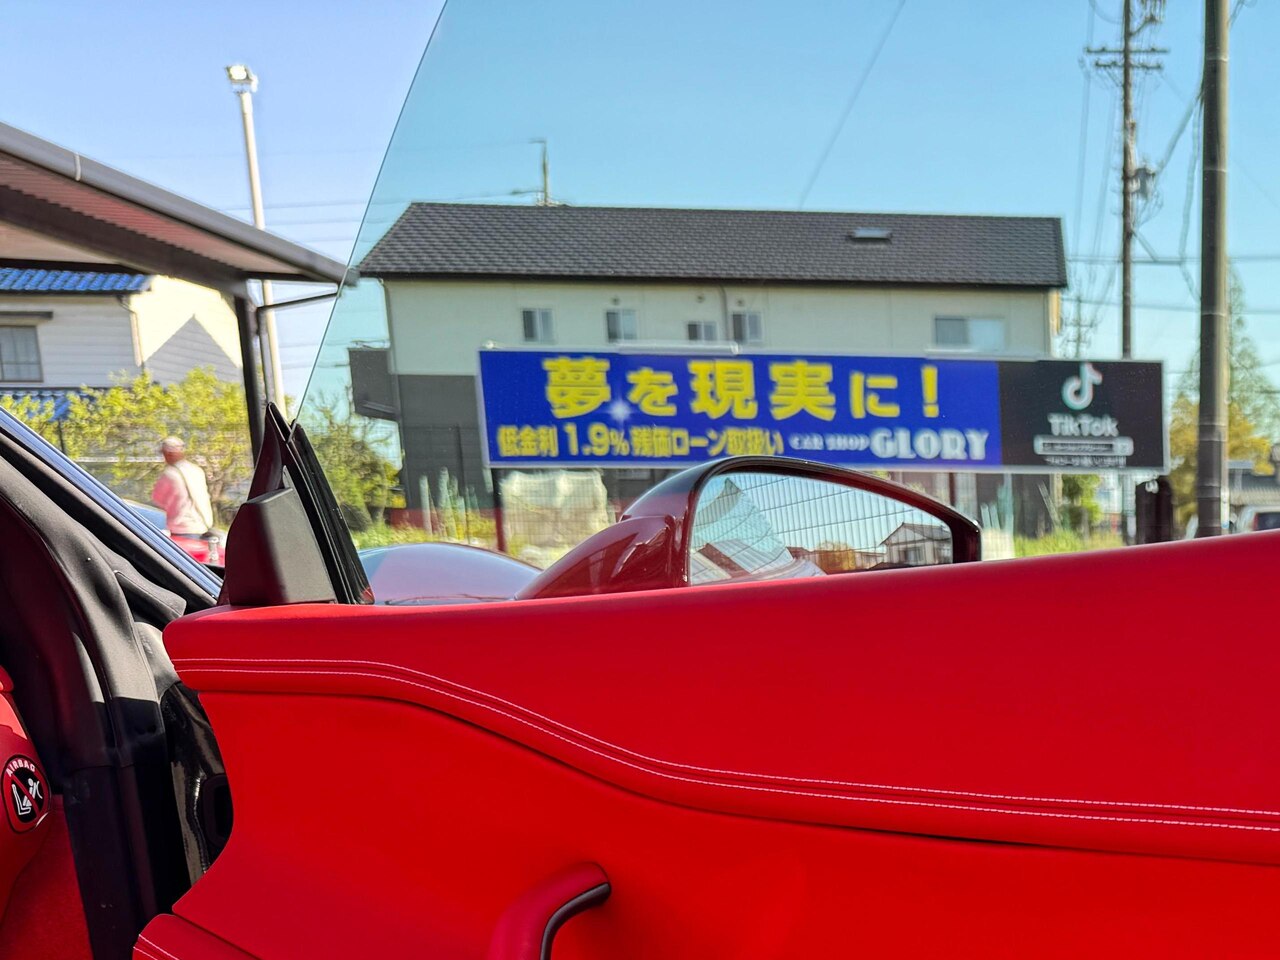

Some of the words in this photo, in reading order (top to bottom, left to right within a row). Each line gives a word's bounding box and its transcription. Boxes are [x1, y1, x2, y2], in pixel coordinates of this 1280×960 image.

[542, 357, 938, 420] 夢を現実に！
[1047, 412, 1120, 437] TikTok
[870, 427, 990, 460] GLORY
[6, 759, 36, 777] AIRBAG
